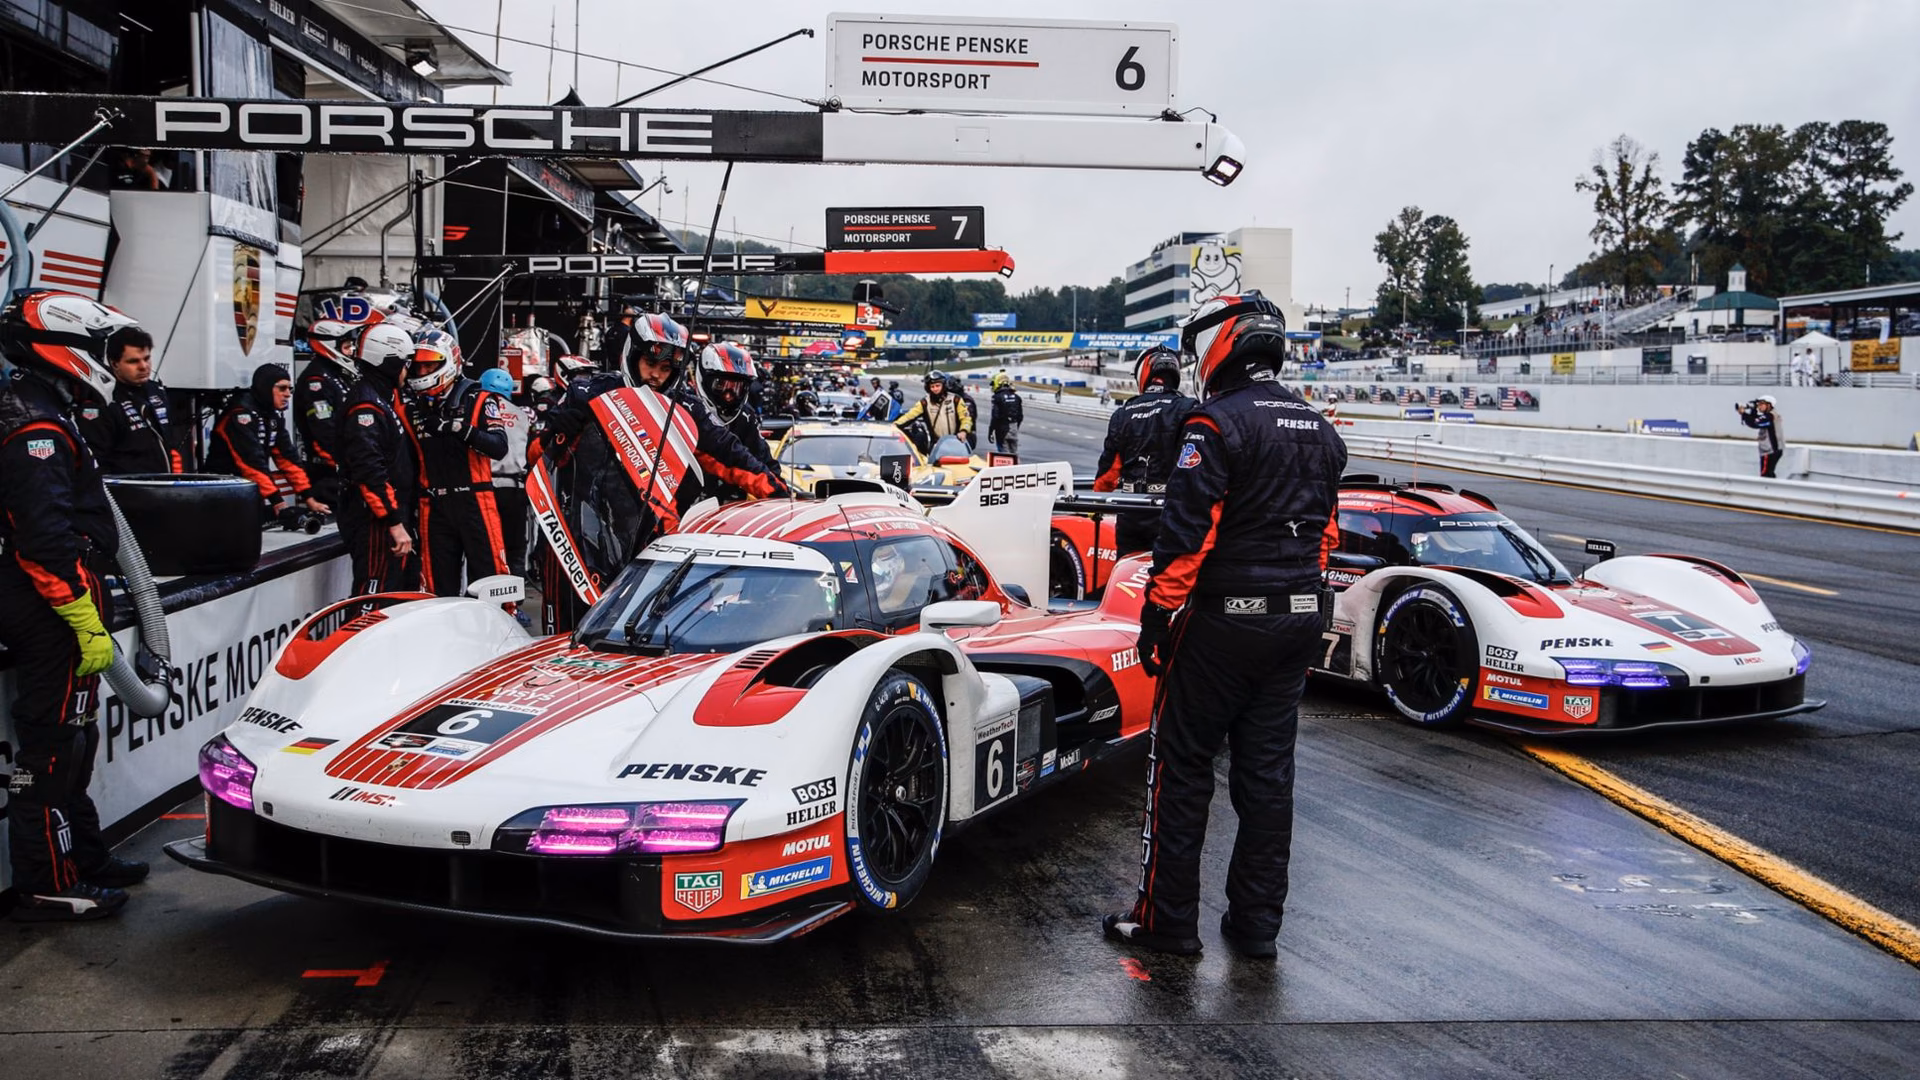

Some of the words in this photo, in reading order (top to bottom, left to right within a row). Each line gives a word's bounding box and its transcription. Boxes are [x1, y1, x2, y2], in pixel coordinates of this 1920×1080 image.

[862, 33, 950, 53] PORSCHE
[956, 37, 1029, 54] PENSKE
[1115, 46, 1146, 91] 6
[861, 70, 991, 90] MOTORSPORT
[155, 101, 712, 154] PORSCHE
[844, 214, 889, 225] PORSCHE
[892, 214, 930, 224] PENSKE
[951, 215, 968, 241] 7
[844, 233, 911, 243] MOTORSPORT
[529, 255, 775, 274] PORSCHE
[774, 310, 842, 319] RACING
[781, 305, 838, 313] CORVETTE
[863, 306, 873, 319] 3
[899, 333, 969, 343] MICHELIN
[995, 335, 1064, 344] MICHELIN
[1088, 340, 1122, 348] FAMILY
[1071, 359, 1098, 367] MOTUL
[613, 398, 640, 432] JAMINET
[1276, 418, 1319, 431] PENSKE
[1650, 426, 1689, 436] MICHELIN
[612, 428, 641, 469] VANTHOOR
[648, 446, 671, 474] TADY
[979, 471, 1057, 493] PORSCHE
[979, 493, 1009, 507] 963
[543, 509, 588, 589] TAGHeuer
[648, 543, 795, 561] PORSCHE
[1086, 546, 1117, 561] PENS
[1587, 543, 1612, 552] HELLER
[489, 586, 518, 597] HELLER
[1386, 589, 1420, 619] MICHELIN
[1655, 615, 1692, 630] 7
[1321, 632, 1341, 669] 7
[1487, 645, 1517, 660] BOSS
[1540, 637, 1613, 650] PENSKE
[1111, 647, 1141, 672] HEL
[1485, 657, 1525, 672] HELLER
[1486, 673, 1523, 686] MOTUL
[479, 686, 556, 701] Ansys
[1501, 692, 1543, 705] MICHELIN
[1565, 696, 1591, 706] TAG
[450, 698, 542, 714] WeatherTech
[1565, 704, 1592, 717] HEUER
[238, 706, 304, 734] PENSKE
[436, 709, 494, 735] 6
[977, 718, 1014, 740] WeatherTech
[986, 739, 1004, 799] 6
[1059, 751, 1076, 770] Mobil
[616, 763, 767, 788] PENSKE
[797, 779, 835, 803] BOSS
[786, 800, 837, 825] HELLER
[782, 834, 832, 857] MOTUL
[681, 875, 719, 888] TAG
[768, 864, 824, 886] MICHELIN
[851, 843, 884, 903] MICHELIN
[677, 889, 720, 909] HEUER
